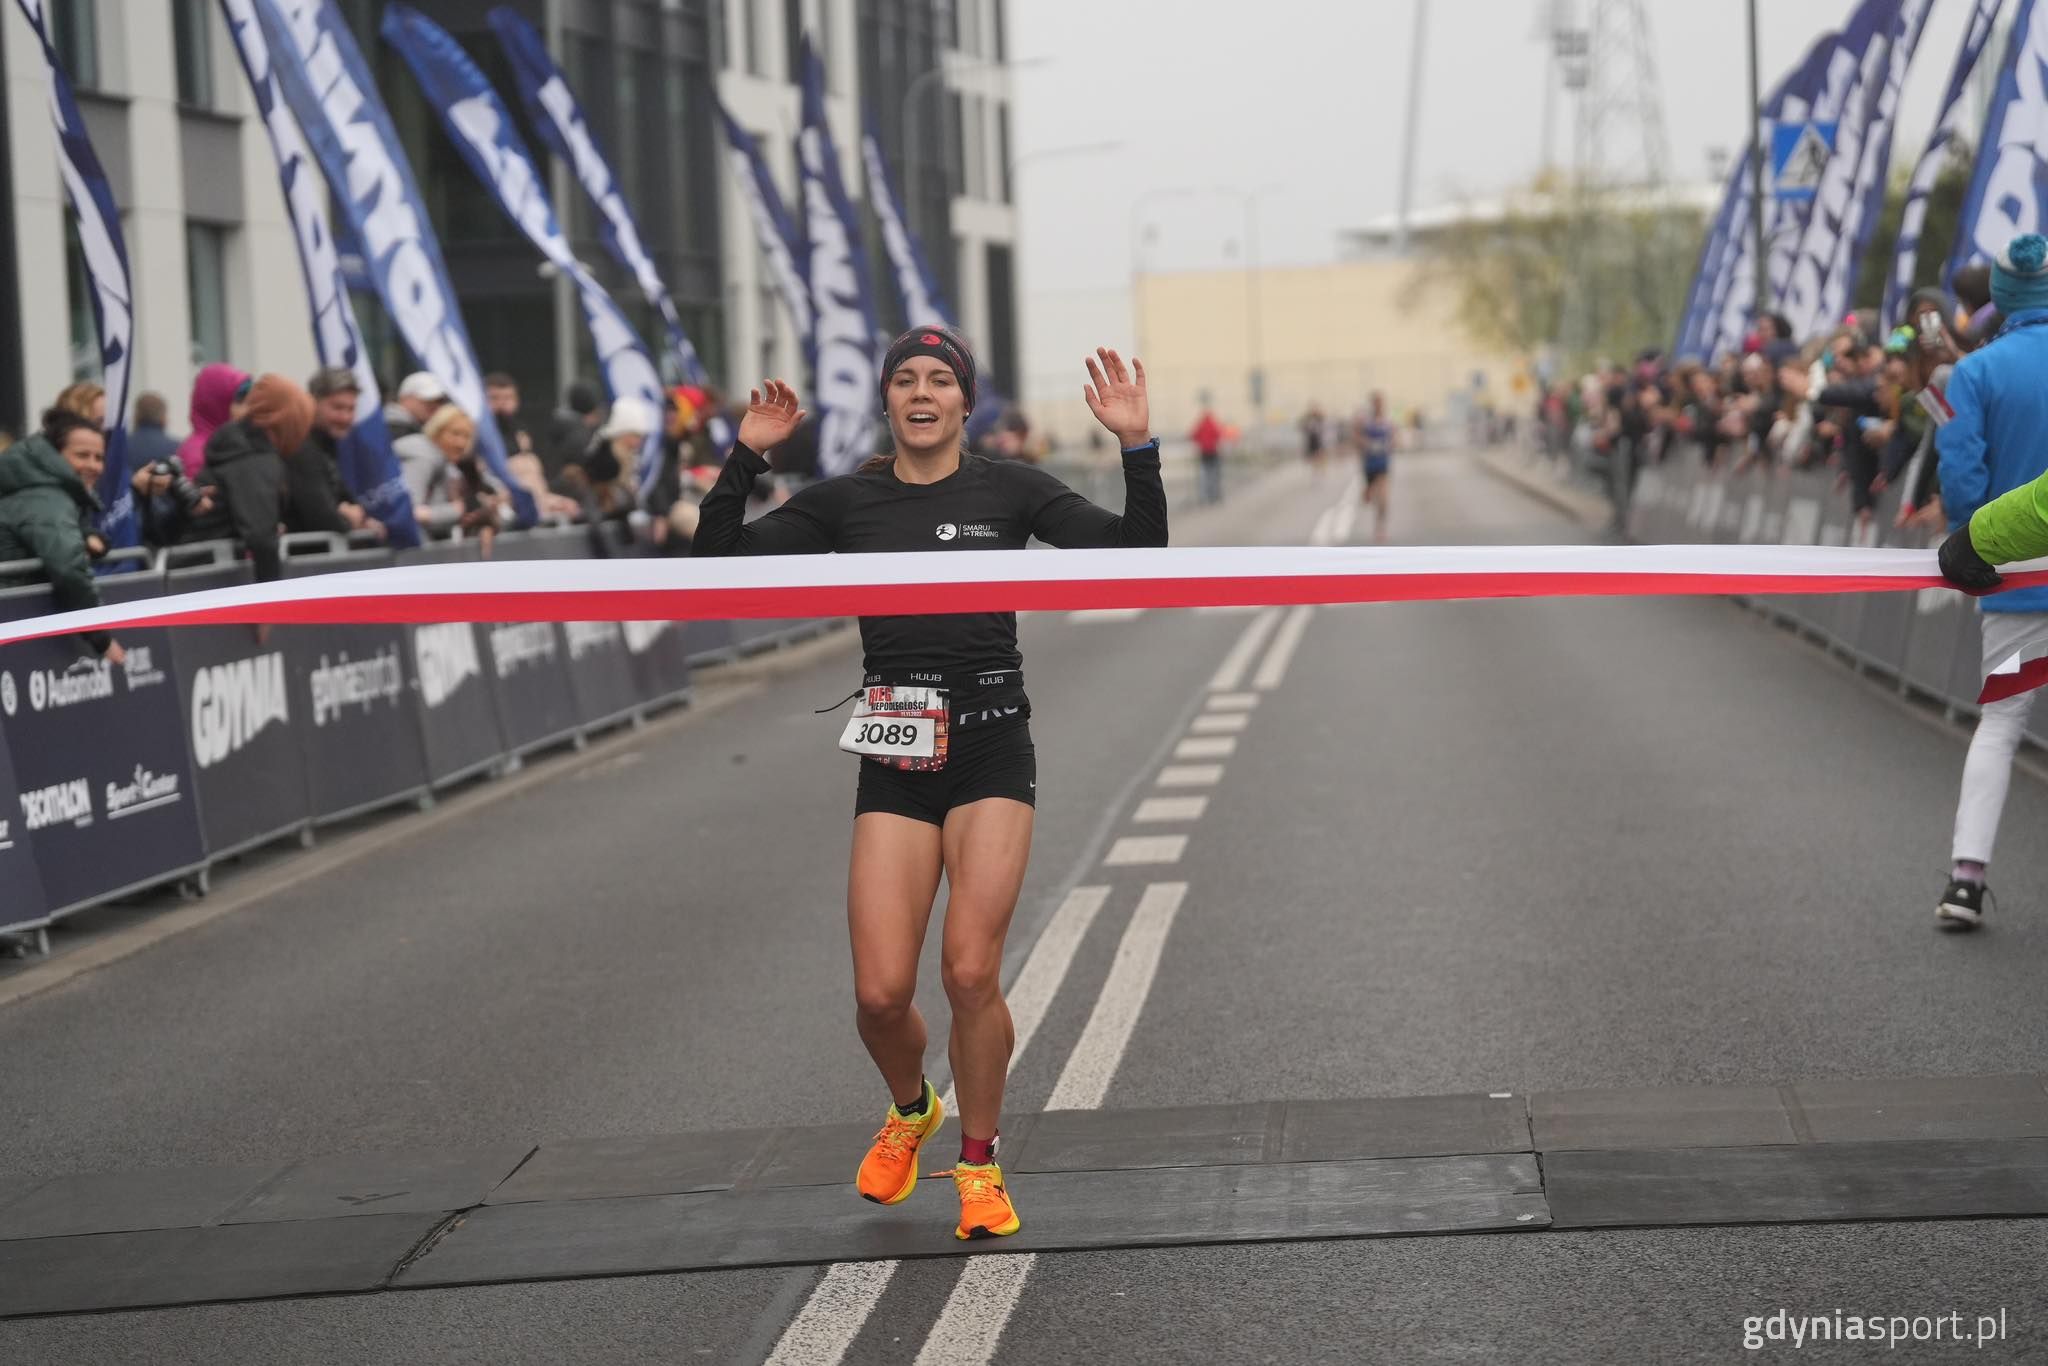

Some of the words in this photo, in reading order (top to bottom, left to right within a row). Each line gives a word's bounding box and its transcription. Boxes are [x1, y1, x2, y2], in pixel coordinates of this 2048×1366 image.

[910, 673, 942, 681] HUUB
[192, 651, 289, 769] GDYNIA
[855, 723, 917, 745] 3089
